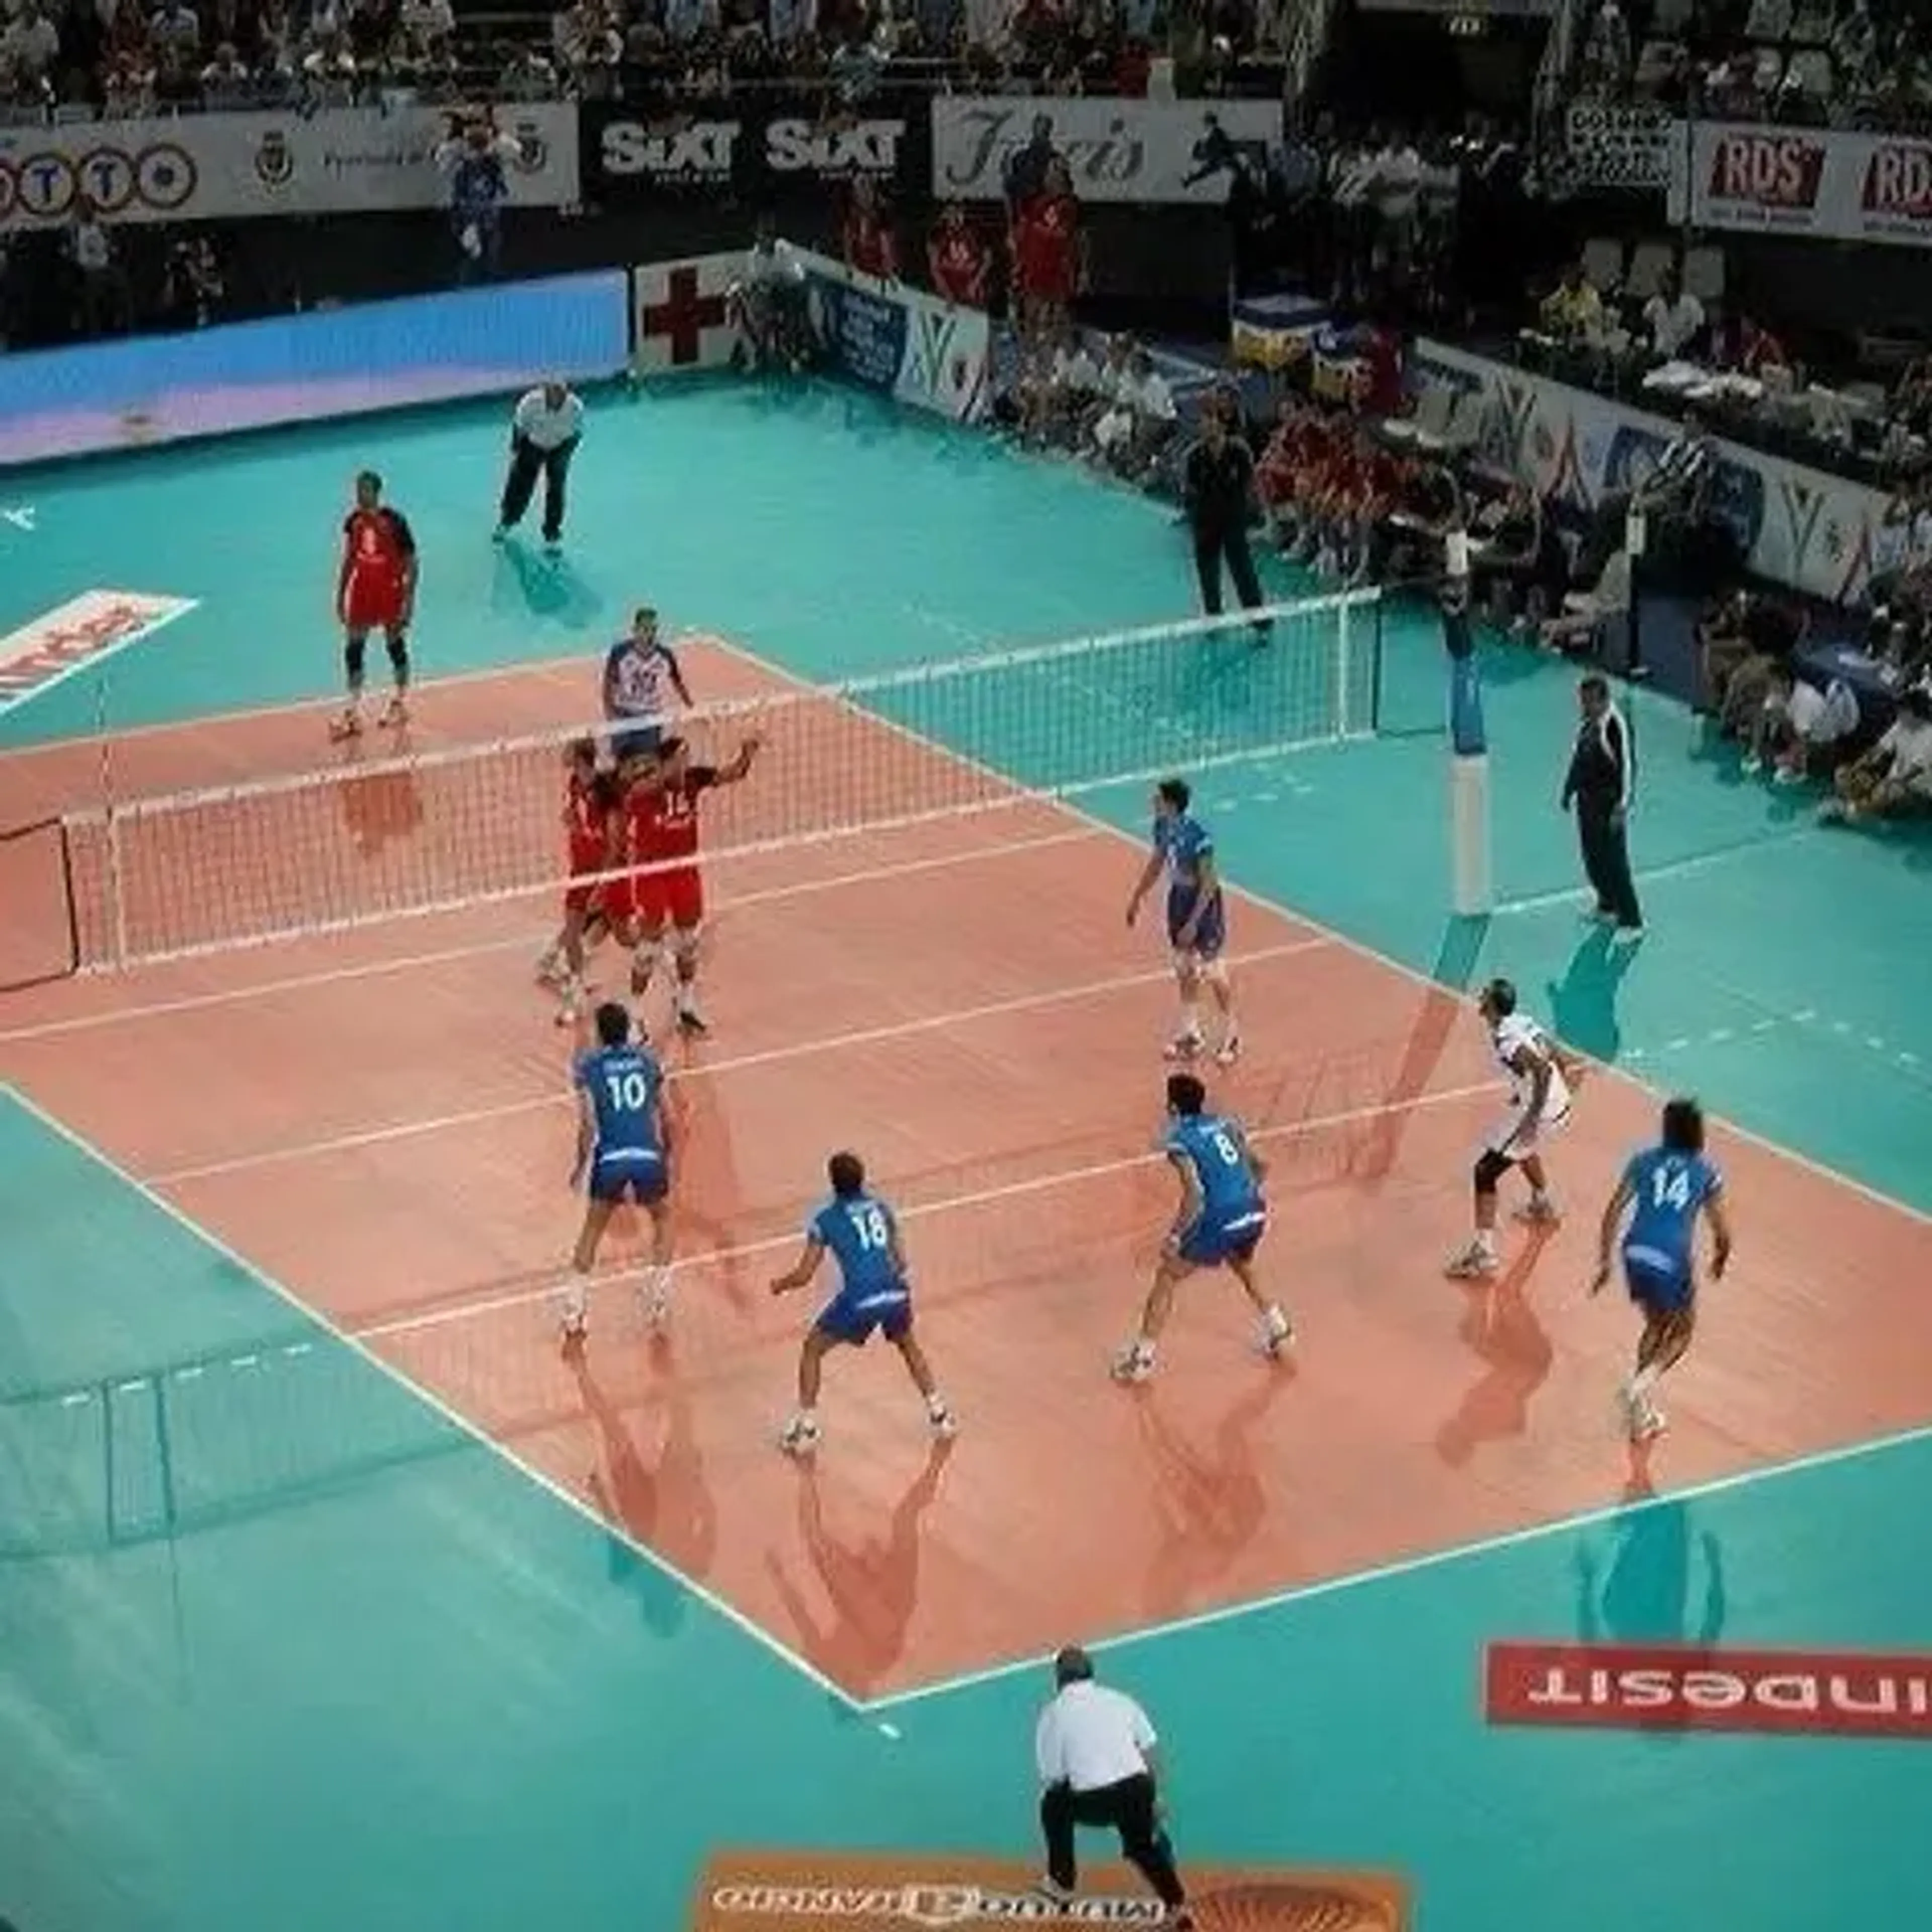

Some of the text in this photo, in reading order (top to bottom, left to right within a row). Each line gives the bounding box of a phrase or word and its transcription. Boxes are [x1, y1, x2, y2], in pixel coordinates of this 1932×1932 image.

[1726, 138, 1801, 202] RDS
[1877, 149, 1932, 204] RD
[606, 1073, 646, 1110] 10
[1214, 1134, 1238, 1165] 8
[1653, 1167, 1689, 1210] 14
